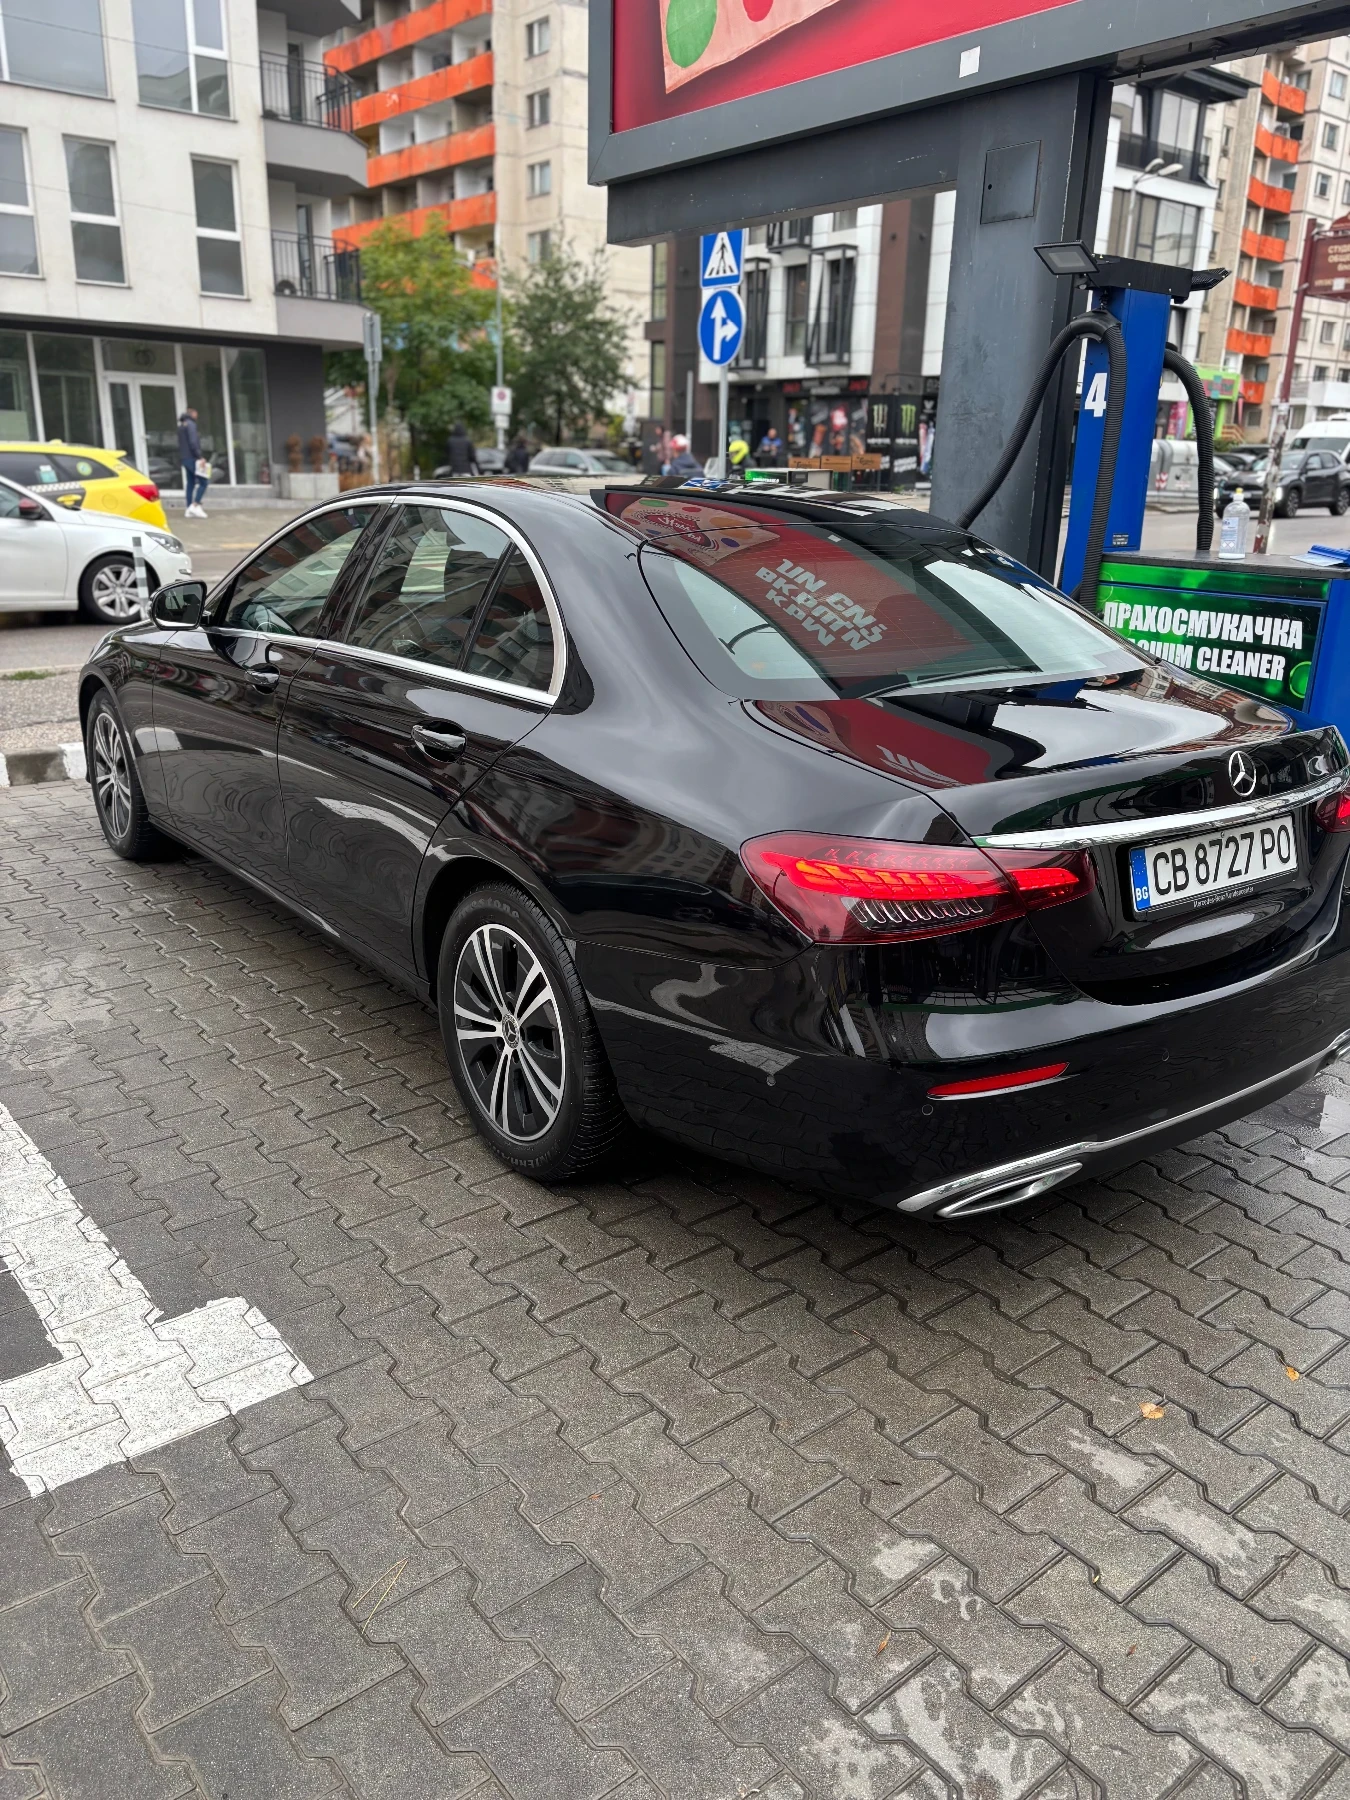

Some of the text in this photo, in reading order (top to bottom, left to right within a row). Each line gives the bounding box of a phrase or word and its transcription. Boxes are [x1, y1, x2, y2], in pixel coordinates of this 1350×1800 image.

[1085, 373, 1107, 417] 4
[1103, 602, 1303, 649] ПРАХОСМУКАЧКА
[1196, 647, 1286, 681] CLEANER
[1153, 824, 1291, 896] CB 8727 PO
[1135, 886, 1149, 901] BG
